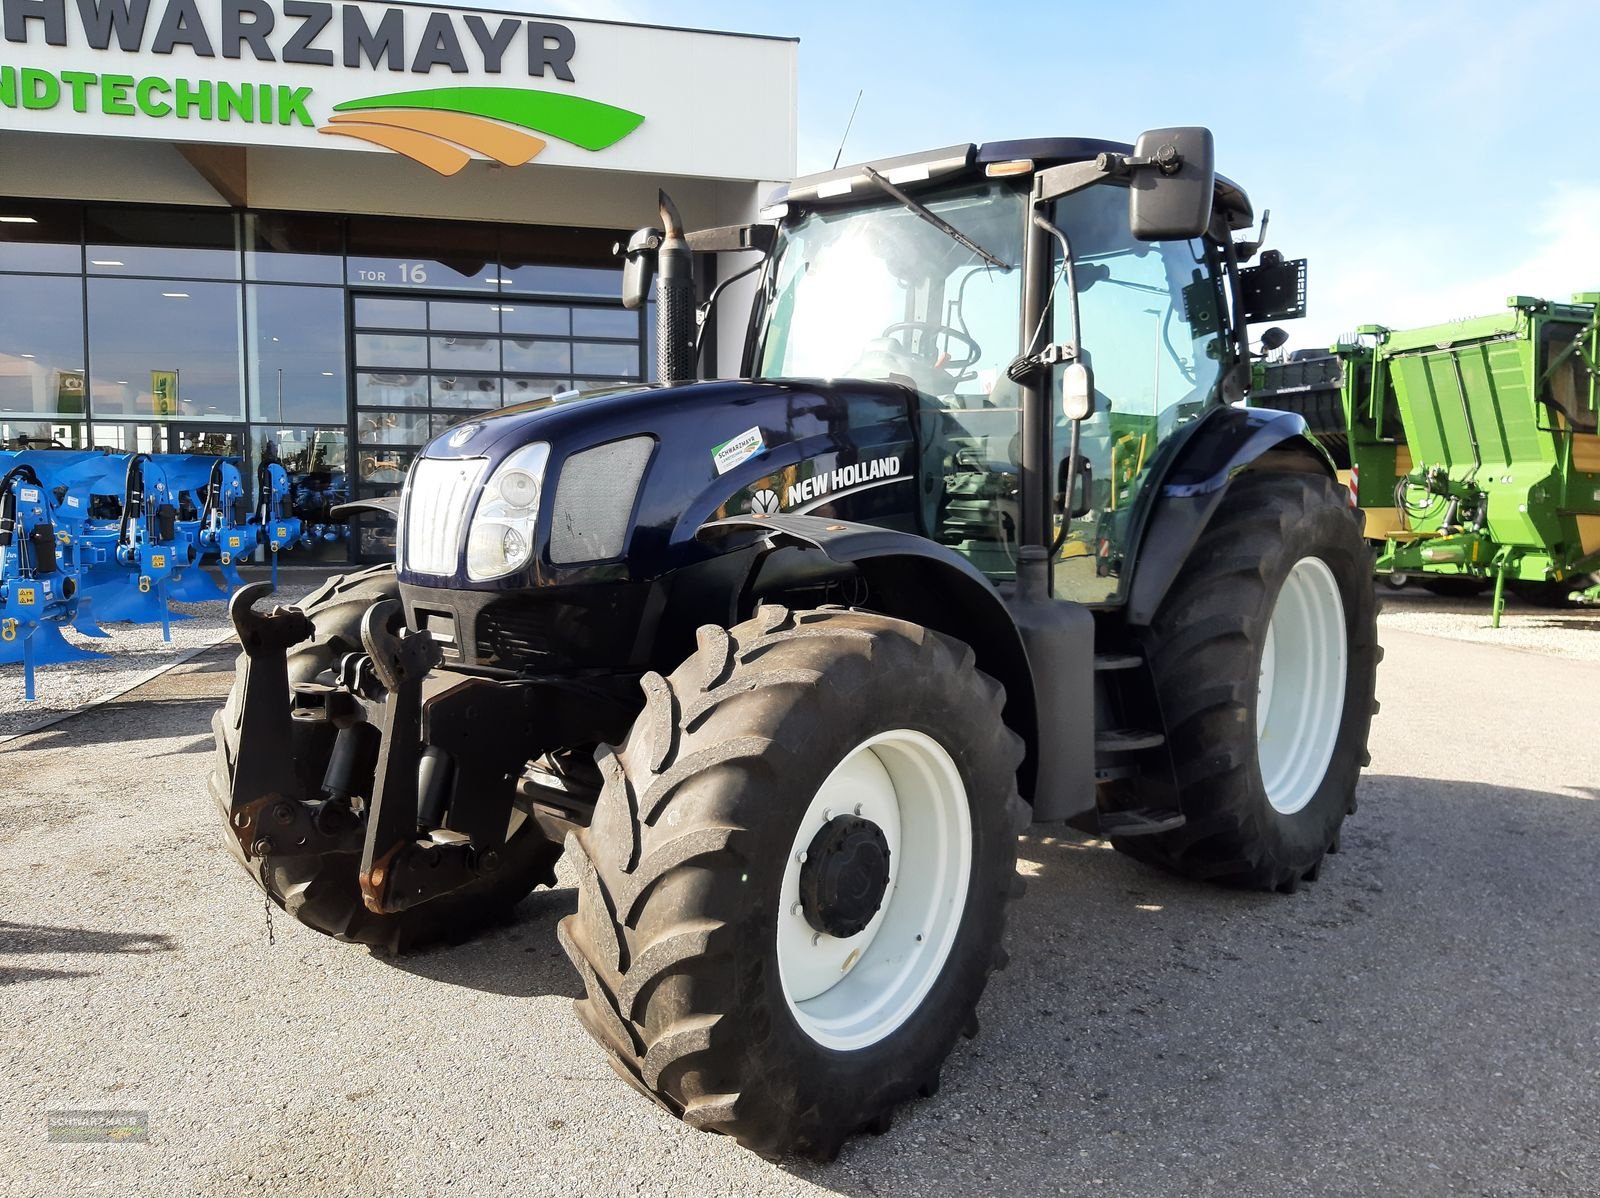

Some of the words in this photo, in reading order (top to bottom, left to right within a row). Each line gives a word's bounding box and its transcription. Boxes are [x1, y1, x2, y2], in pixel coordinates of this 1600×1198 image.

[359, 270, 386, 281] TOR
[399, 263, 427, 283] 16
[718, 436, 755, 459] SCHWARZMAYR
[788, 473, 828, 507] NEW
[831, 456, 900, 491] HOLLAND
